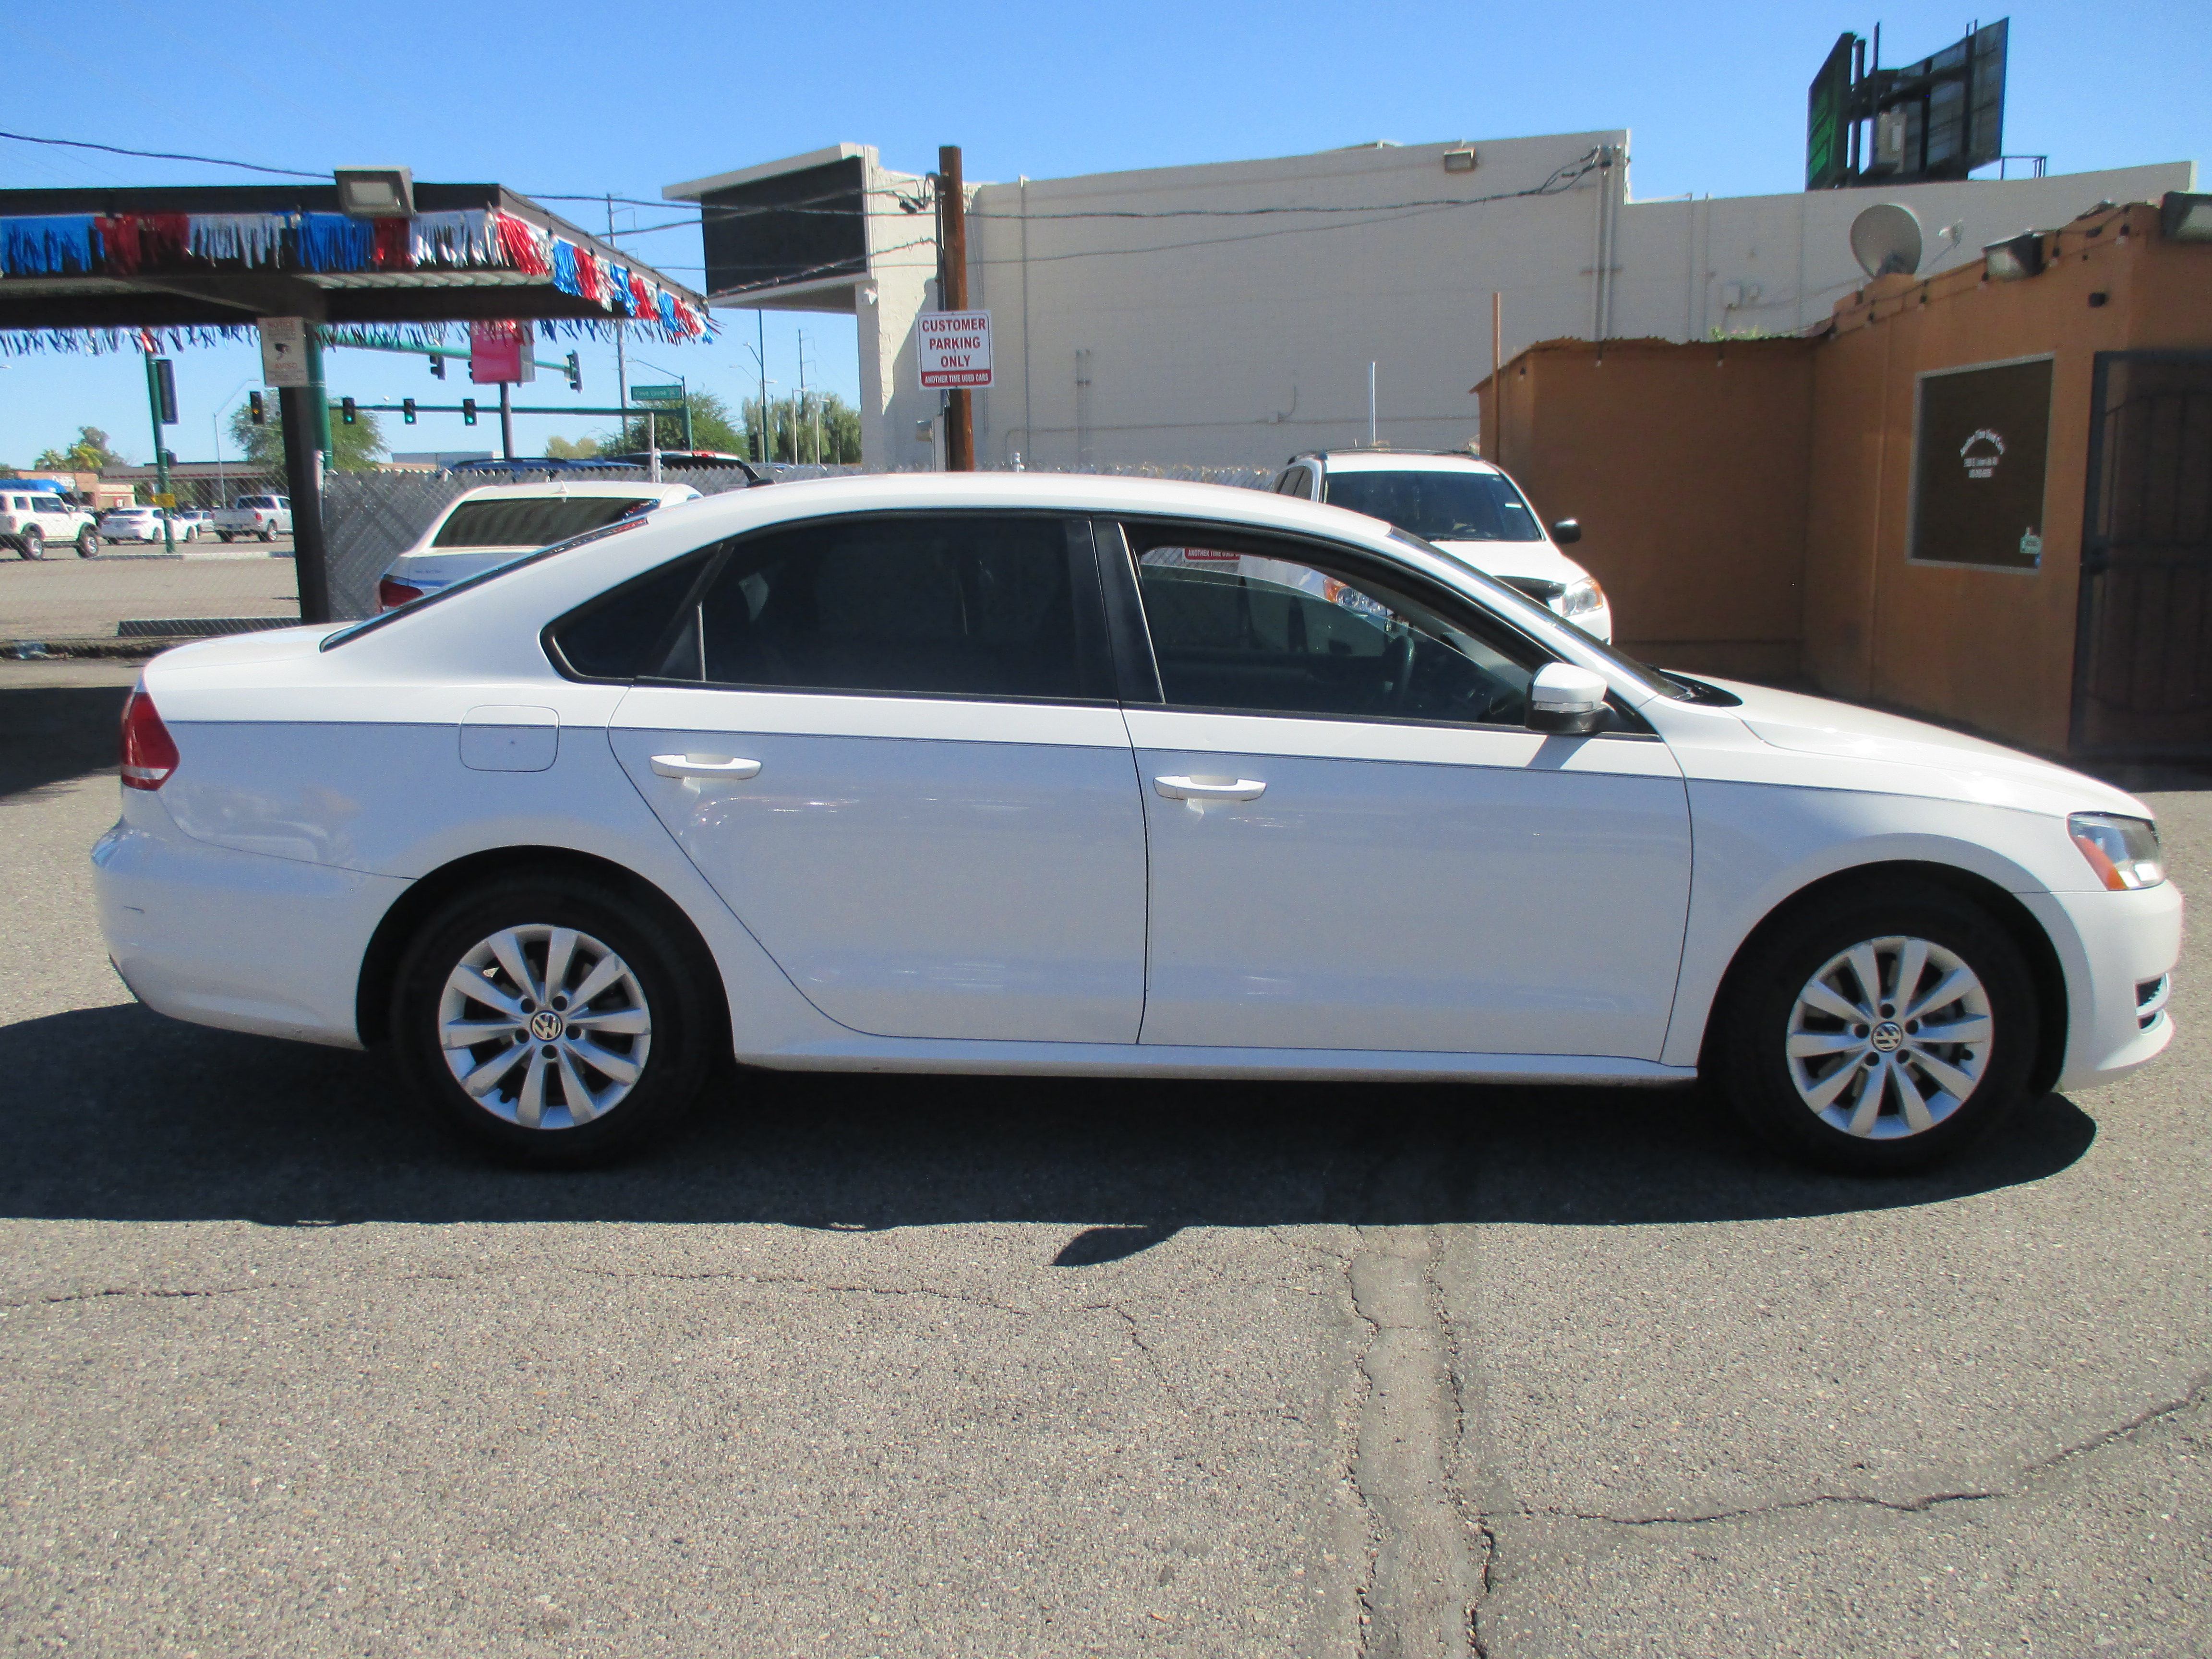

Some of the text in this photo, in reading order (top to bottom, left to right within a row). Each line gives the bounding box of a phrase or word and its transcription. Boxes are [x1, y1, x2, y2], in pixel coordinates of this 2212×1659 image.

[922, 318, 986, 332] CUSTOMER
[929, 337, 981, 350] PARKING
[941, 355, 971, 368] ONLY
[925, 373, 989, 384] ANOTHER TIME USED CARS
